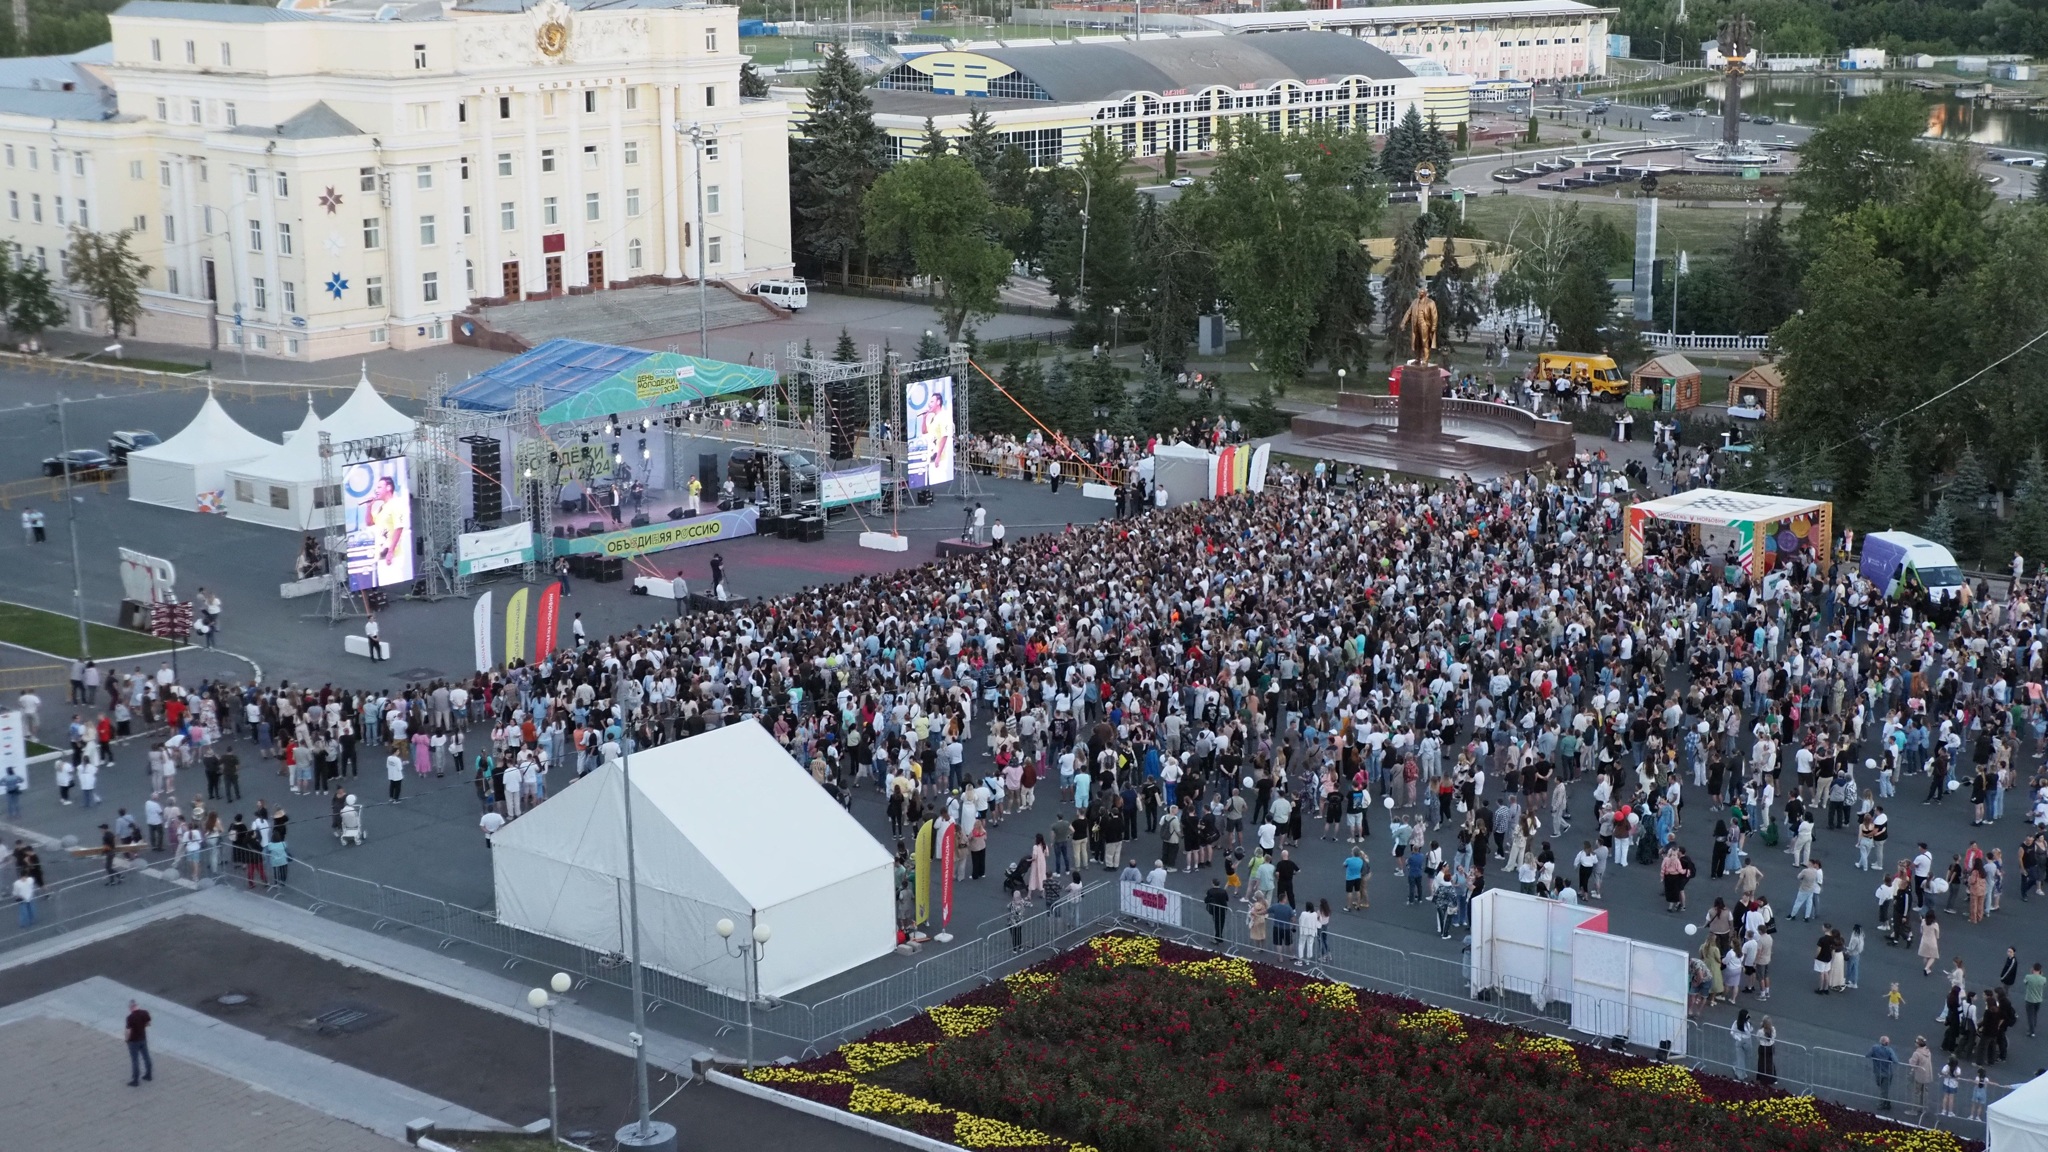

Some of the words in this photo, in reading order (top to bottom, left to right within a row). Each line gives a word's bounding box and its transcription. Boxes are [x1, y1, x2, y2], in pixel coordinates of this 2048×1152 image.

[480, 85, 515, 94] ДОМ
[538, 77, 626, 91] СОВЕТОВ
[637, 374, 654, 383] ДЕНЬ
[607, 531, 672, 553] ОБЪЕДИНЯЯ
[675, 522, 720, 540] РОССИЮ
